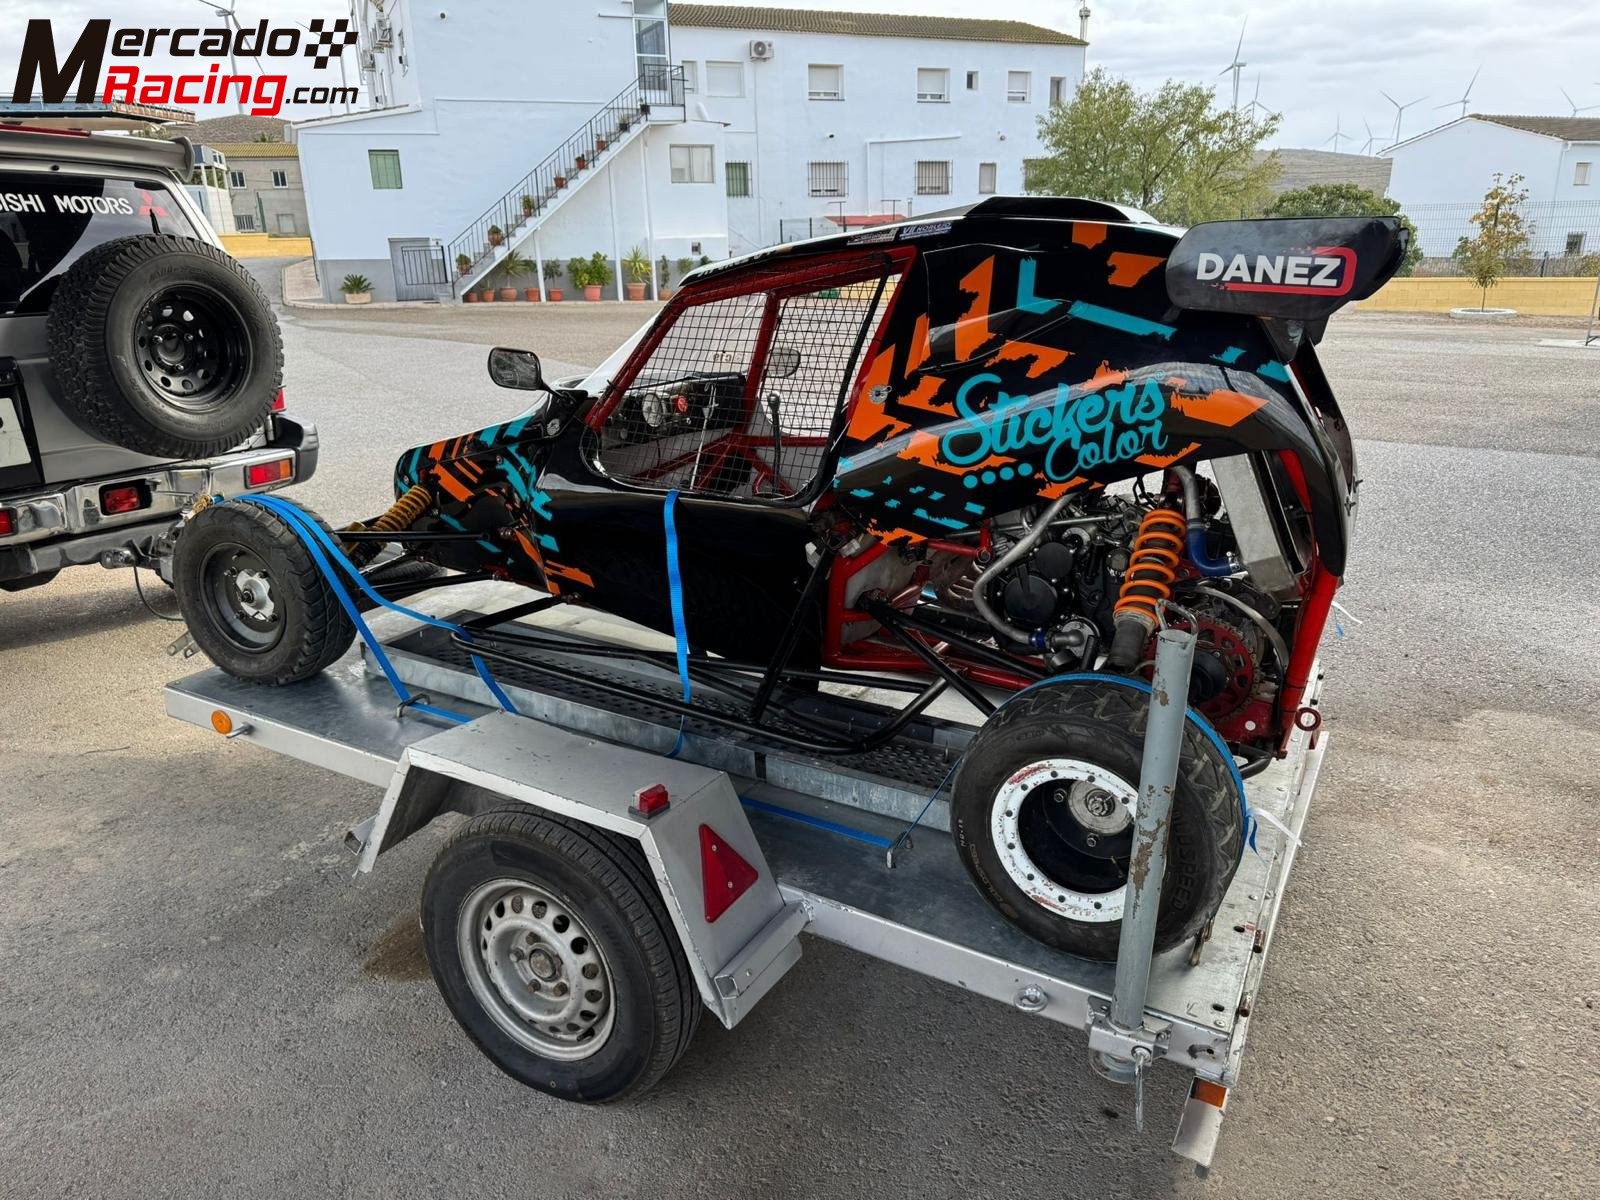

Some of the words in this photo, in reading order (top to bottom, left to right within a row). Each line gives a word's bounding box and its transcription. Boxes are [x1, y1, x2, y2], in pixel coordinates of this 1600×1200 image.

[0, 193, 46, 212] ISHI
[53, 195, 134, 215] MOTORS
[1197, 252, 1341, 288] DANEZ
[942, 373, 1165, 466] Stickers
[1045, 419, 1168, 481] Color
